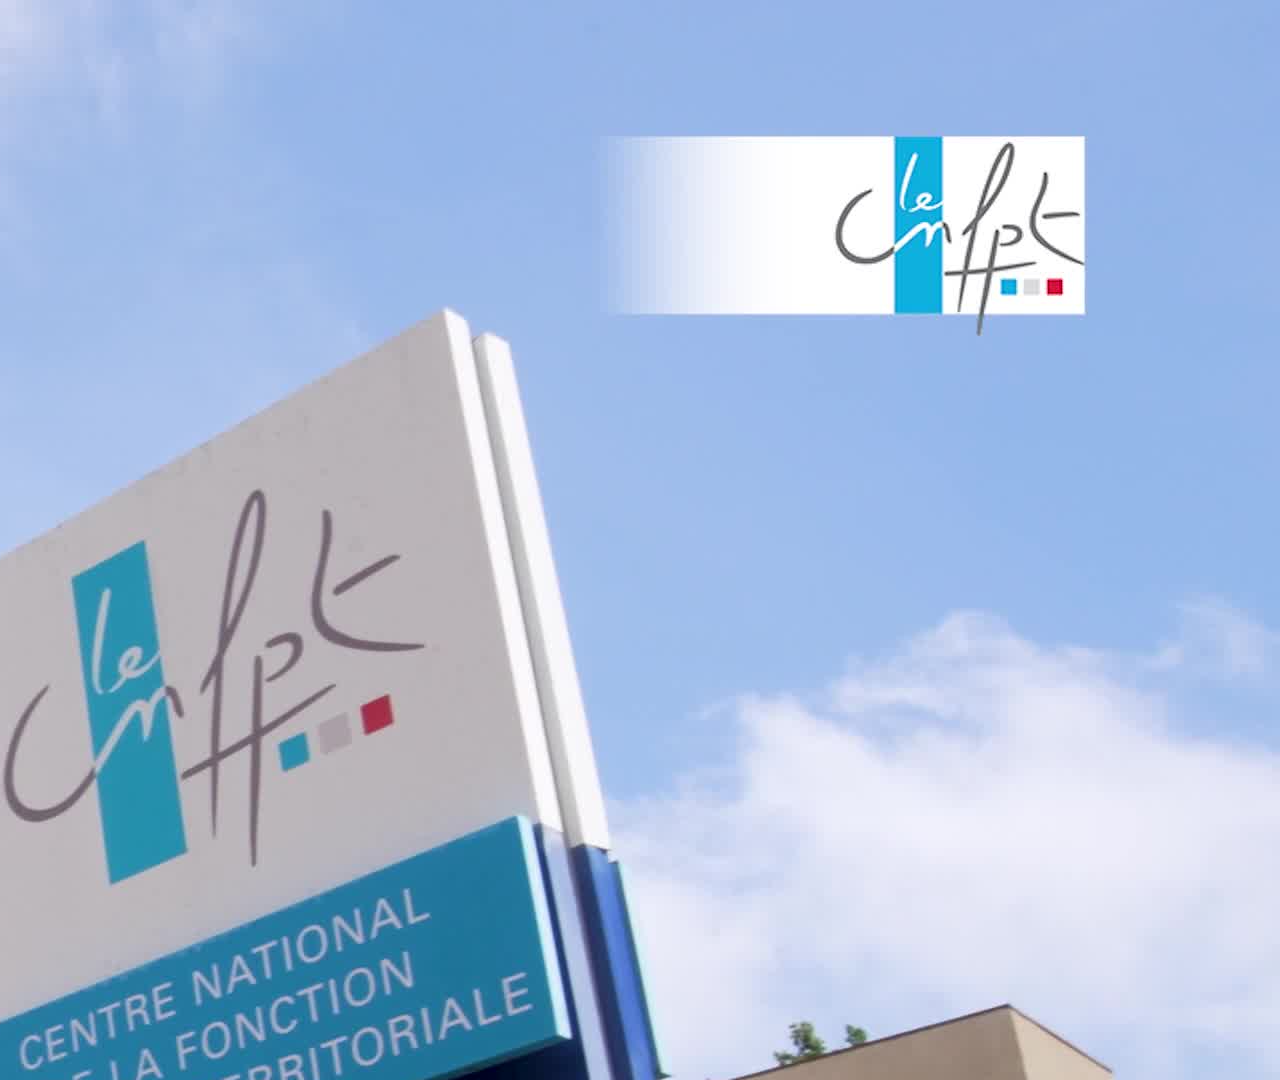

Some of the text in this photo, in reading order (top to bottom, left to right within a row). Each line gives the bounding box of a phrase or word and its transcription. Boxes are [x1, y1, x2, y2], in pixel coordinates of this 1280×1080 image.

[92, 588, 161, 692] le
[19, 888, 430, 1071] CENTRE NATIONAL
[175, 951, 415, 1070] FONCTION
